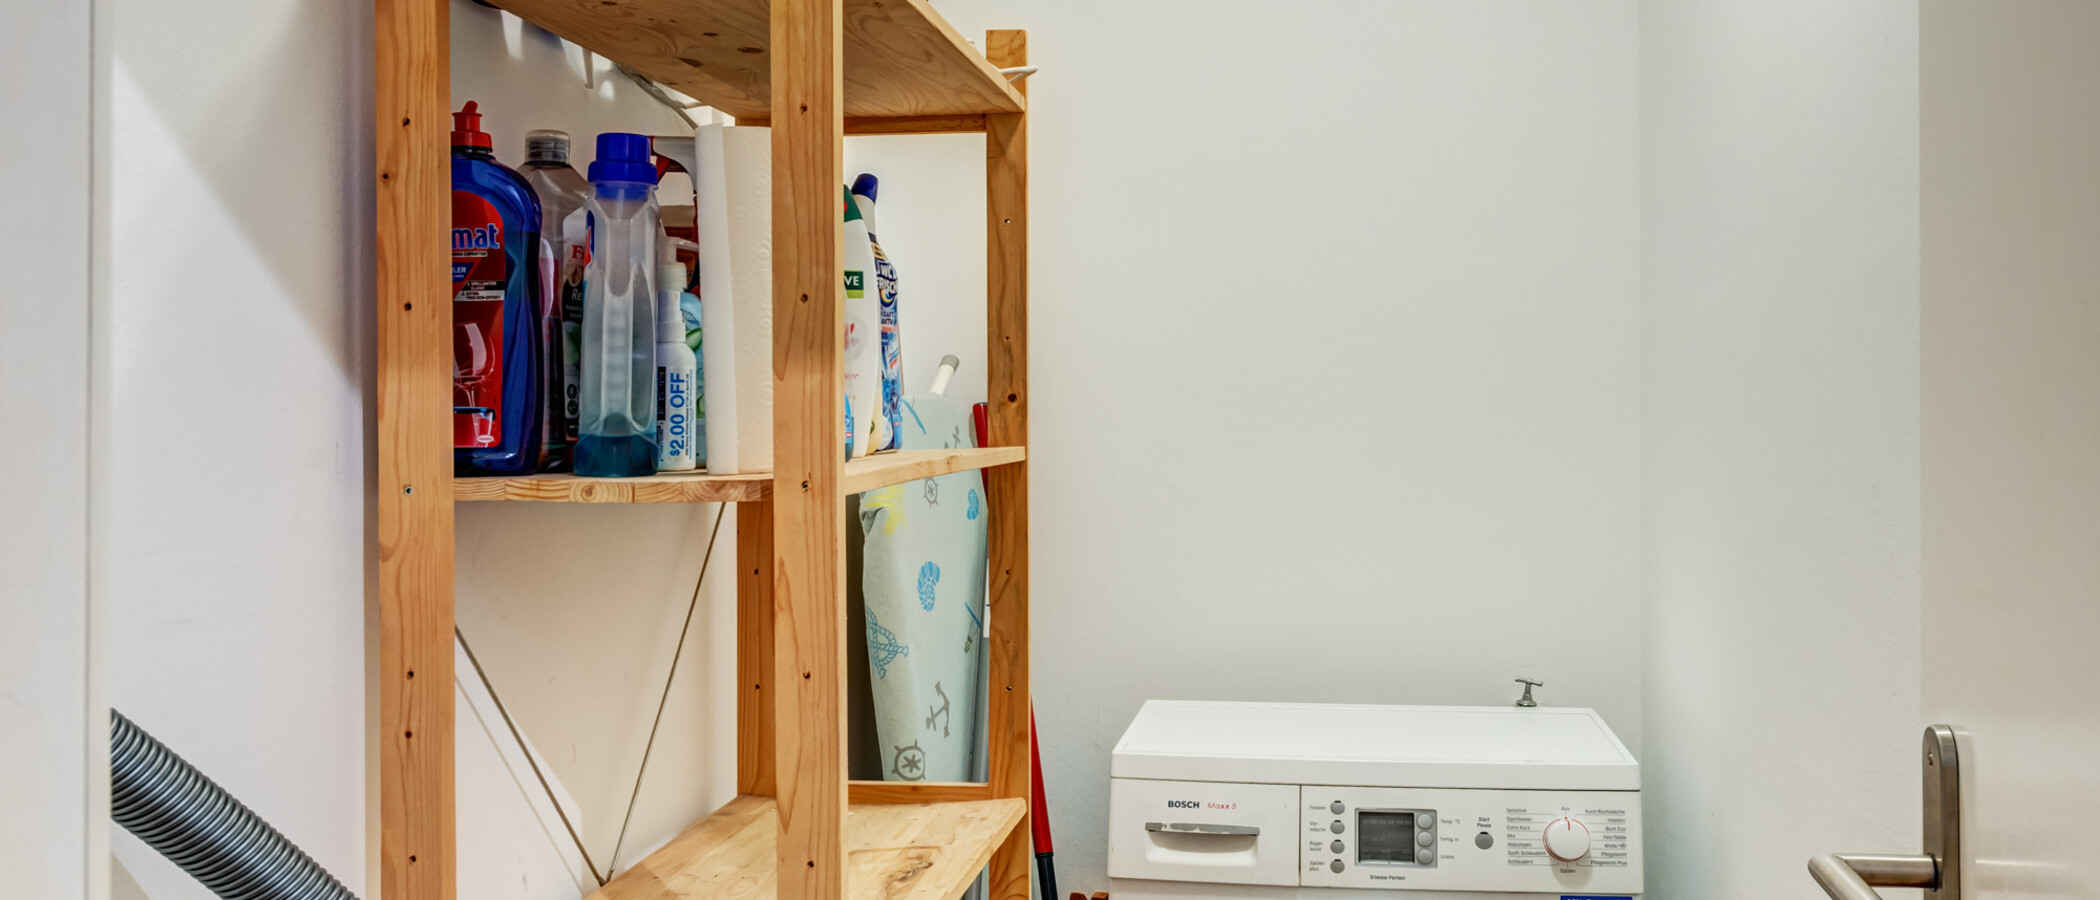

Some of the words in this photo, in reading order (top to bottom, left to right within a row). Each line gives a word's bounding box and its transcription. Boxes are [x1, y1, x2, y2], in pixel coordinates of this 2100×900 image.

[452, 223, 500, 249] mat
[844, 275, 860, 286] VE
[572, 289, 583, 300] Re
[669, 372, 685, 408] OFF
[669, 413, 685, 456] $2.00
[1168, 800, 1200, 809] BOSCH
